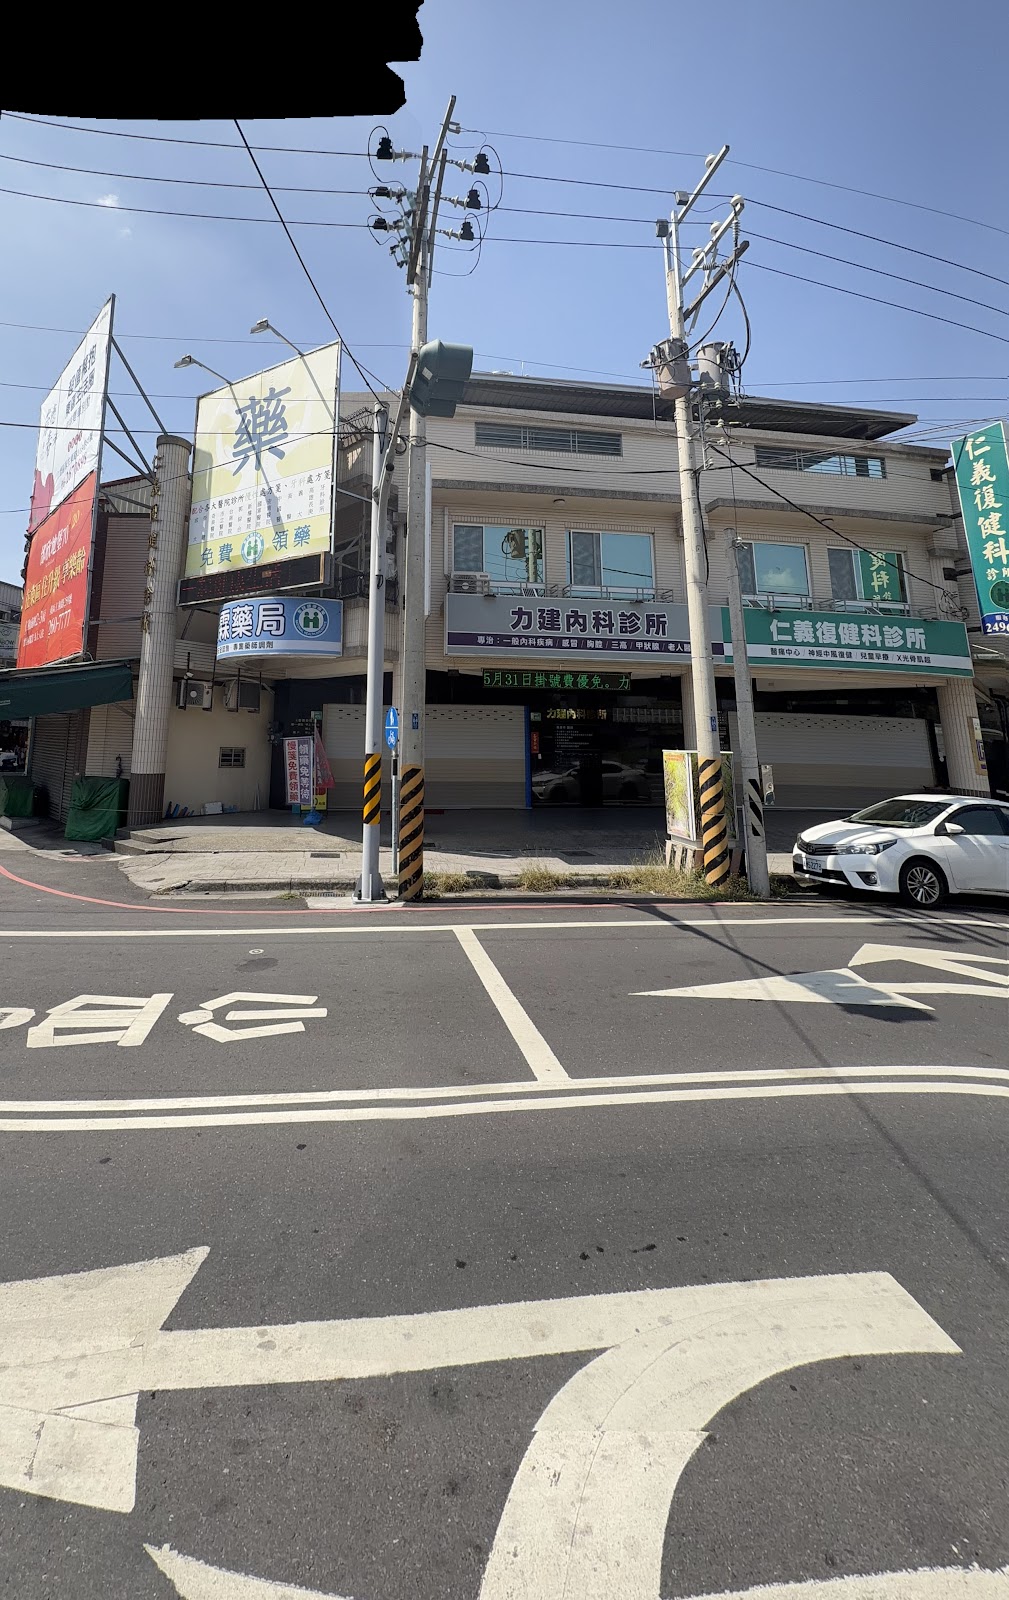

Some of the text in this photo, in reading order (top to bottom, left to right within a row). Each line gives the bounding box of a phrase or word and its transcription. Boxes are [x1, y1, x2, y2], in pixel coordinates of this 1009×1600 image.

[232, 387, 292, 476] 藥
[965, 436, 1009, 565] 仁義復健科
[200, 542, 233, 568] 免費
[272, 524, 311, 552] 領藥
[509, 605, 669, 637] 力建內科診所
[769, 618, 927, 650] 仁義復健科診所
